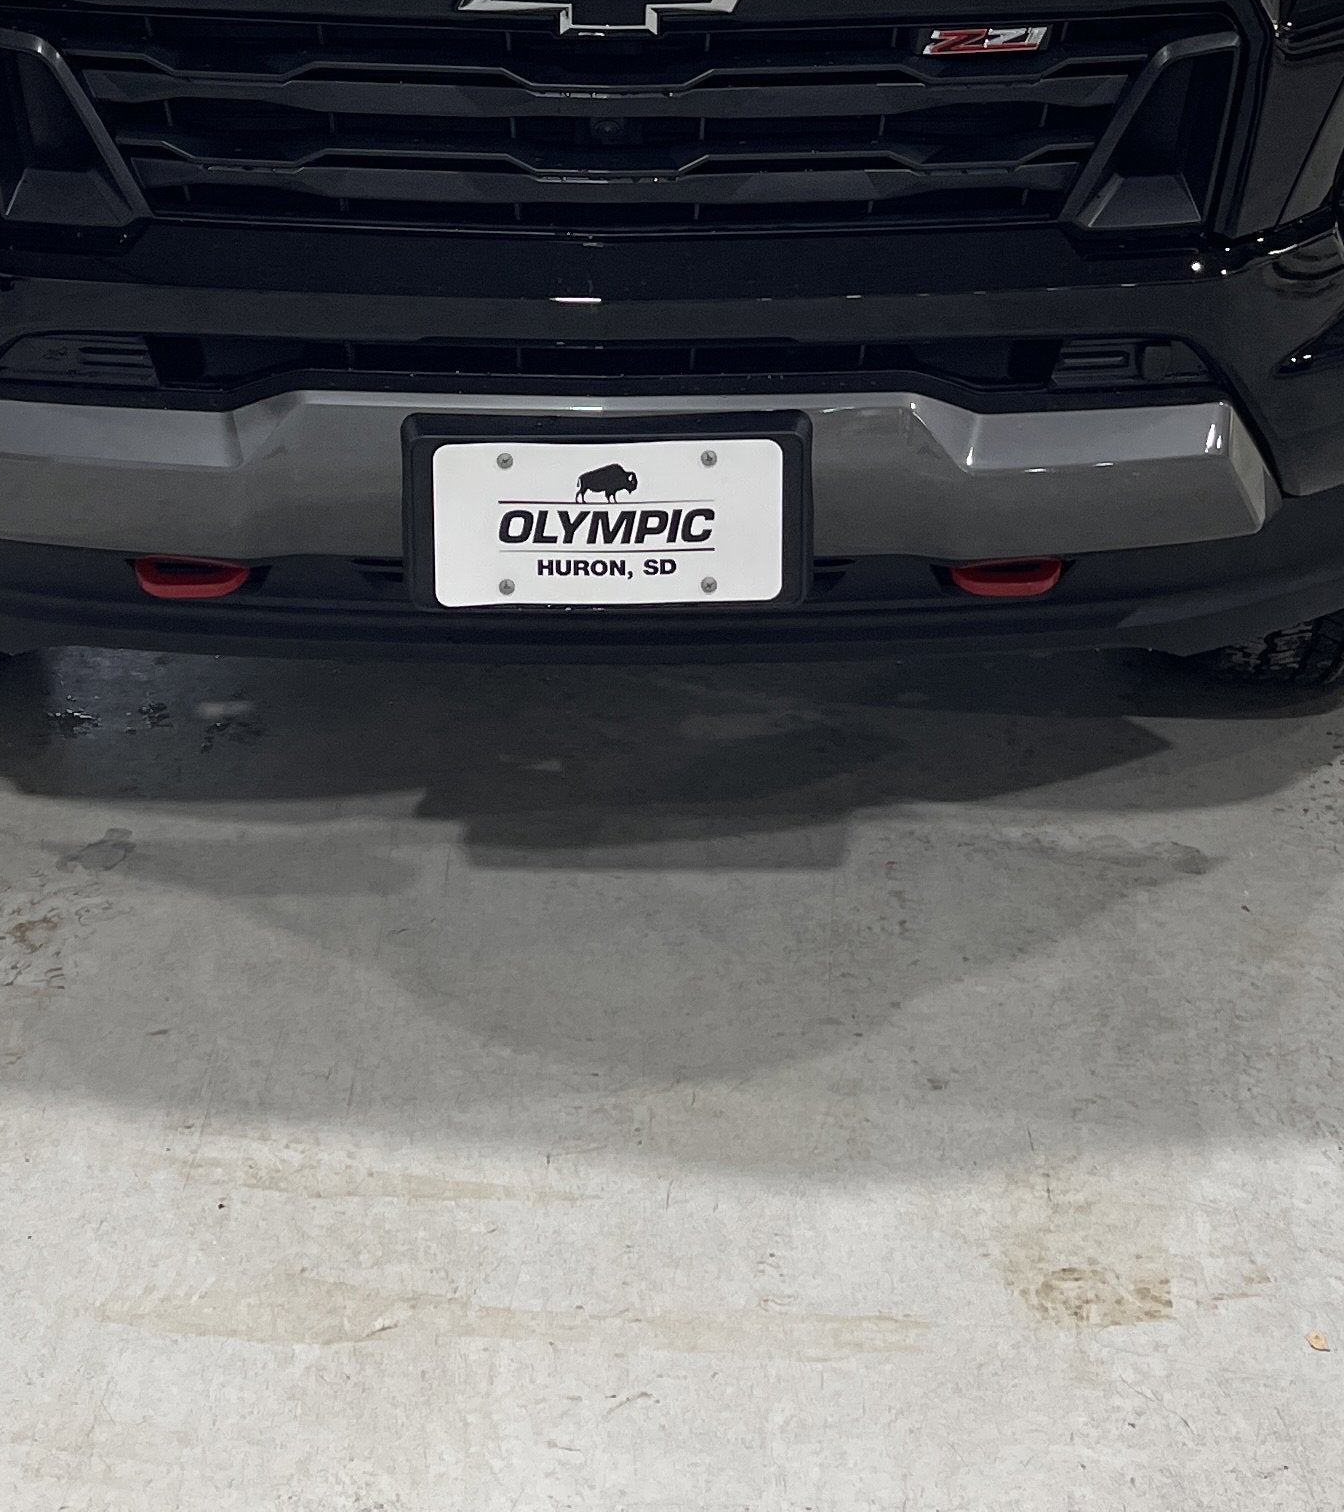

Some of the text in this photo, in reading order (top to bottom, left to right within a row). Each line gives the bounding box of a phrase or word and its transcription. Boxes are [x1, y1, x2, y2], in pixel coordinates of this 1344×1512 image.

[498, 508, 716, 544] OLYMPIC
[537, 558, 677, 580] HURON, SD
